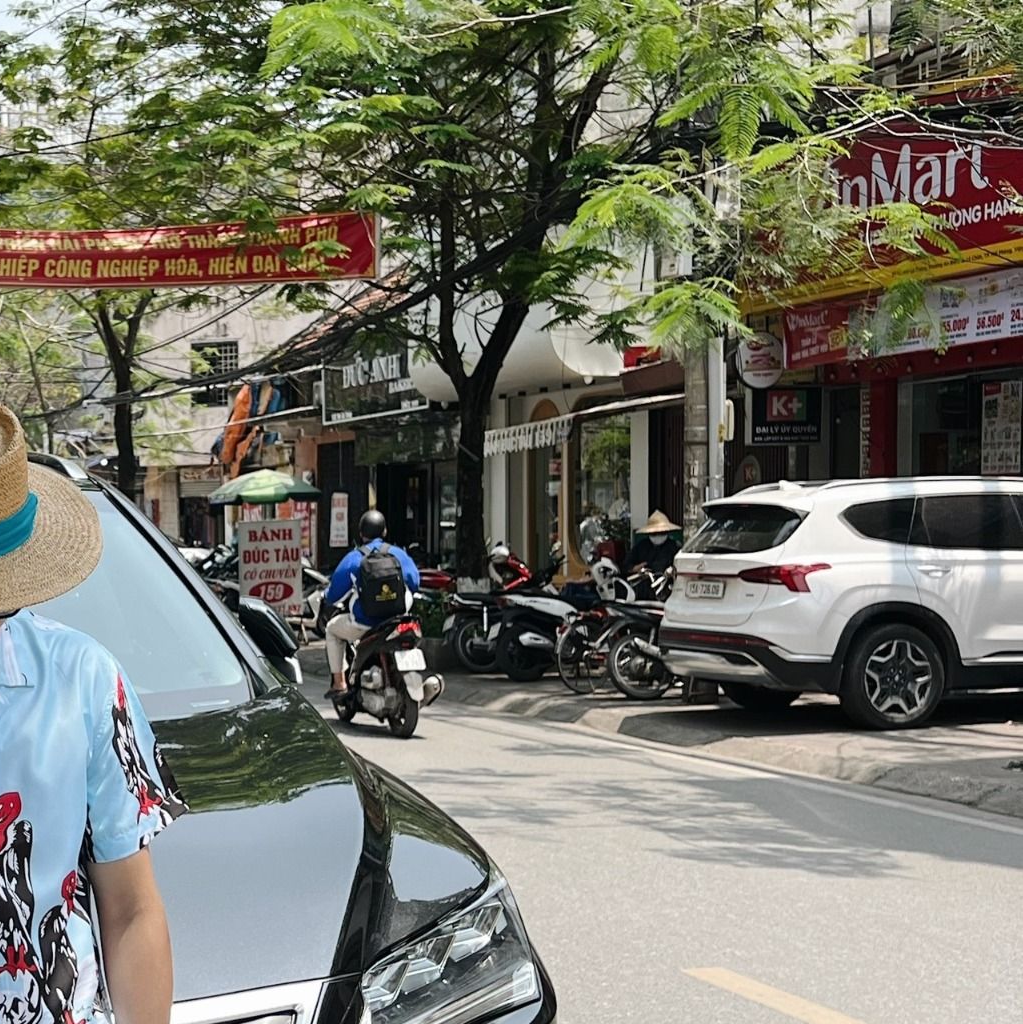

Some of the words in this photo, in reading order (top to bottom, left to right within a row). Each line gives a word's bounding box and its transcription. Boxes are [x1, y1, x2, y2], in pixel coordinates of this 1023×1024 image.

[44, 253, 91, 278] CÔNG
[96, 256, 160, 281] NGHIỆP
[248, 526, 293, 542] BÁNH
[242, 545, 269, 564] ĐÚC
[274, 545, 299, 563] TÀU
[260, 583, 285, 600] 159
